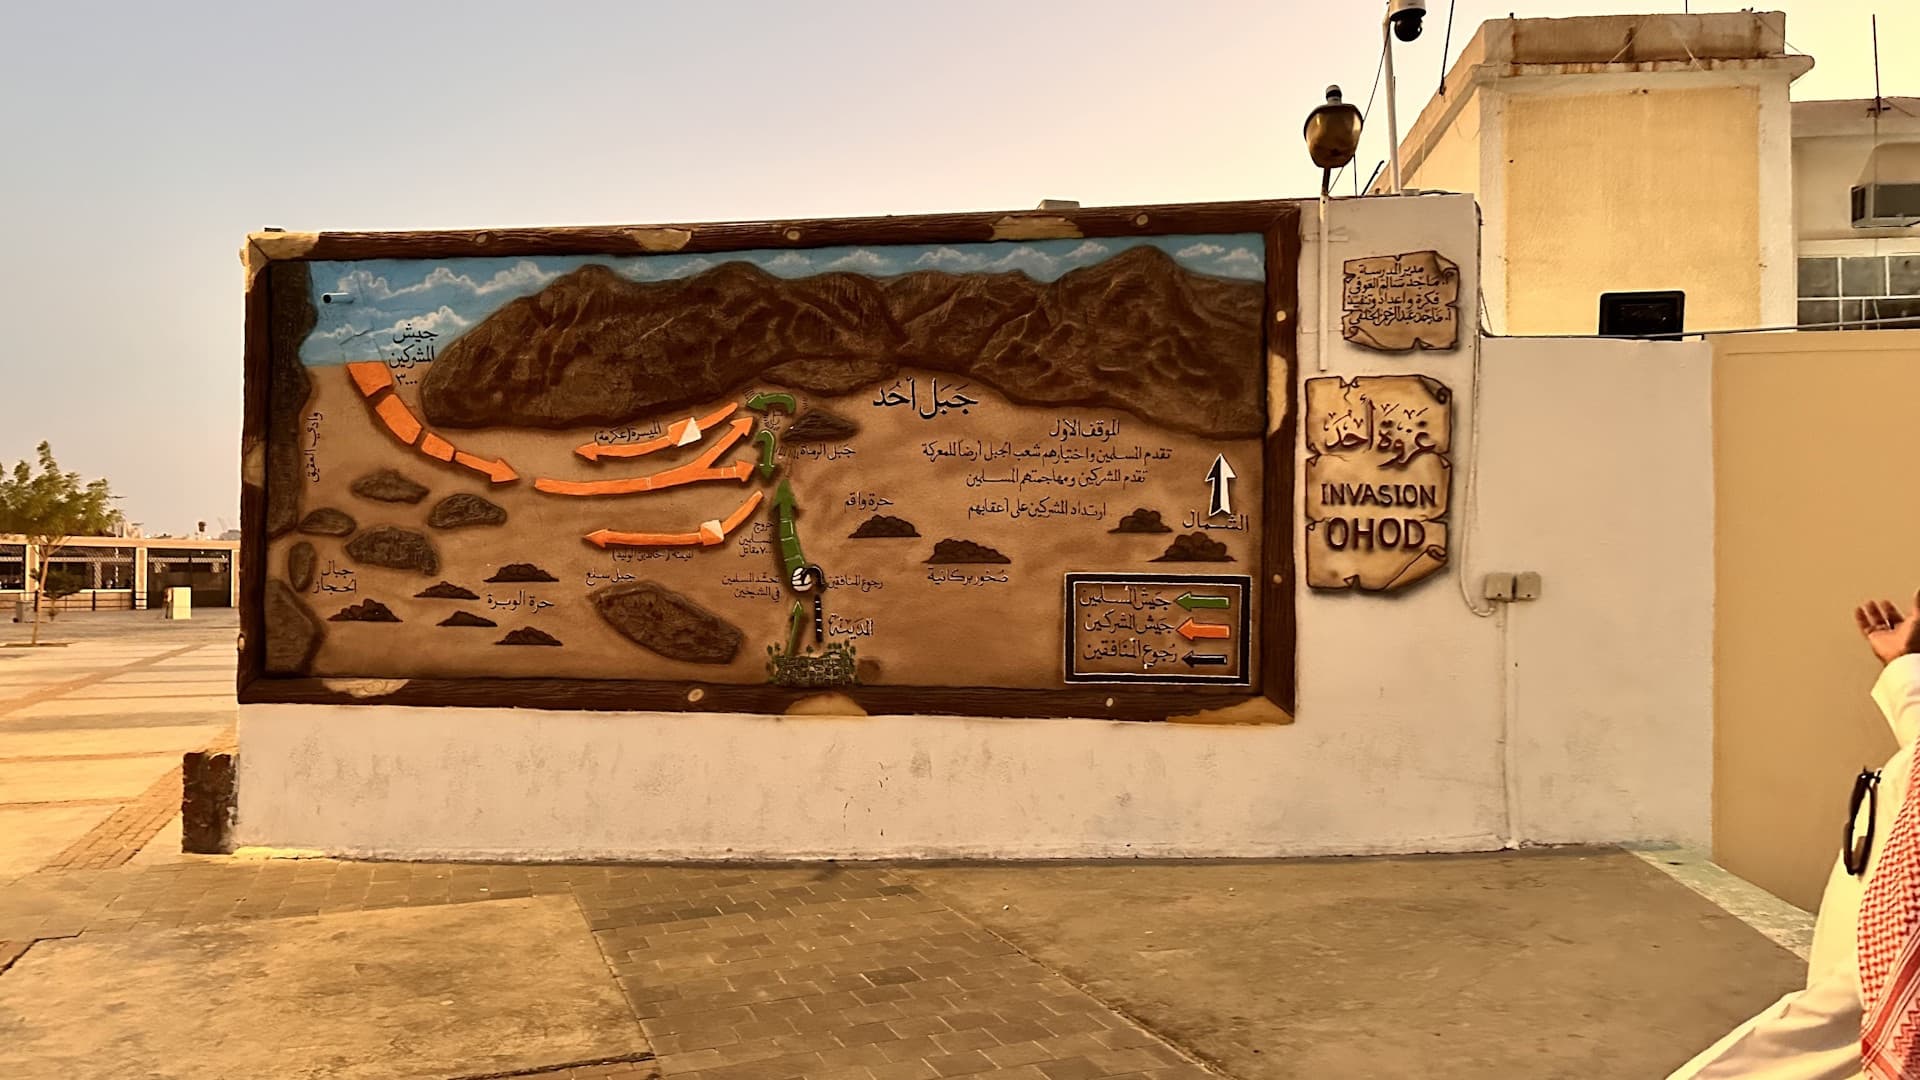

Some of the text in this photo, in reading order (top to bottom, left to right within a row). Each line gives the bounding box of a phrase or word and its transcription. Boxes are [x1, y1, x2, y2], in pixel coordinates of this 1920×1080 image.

[1358, 262, 1425, 278] مدير المدرسة
[1416, 290, 1440, 309] فكرة
[392, 322, 439, 344] جيش
[389, 344, 435, 369] المشركين
[1081, 418, 1120, 442] الموقف
[1096, 445, 1142, 463] المسلمين
[1143, 447, 1173, 466] تقدم
[966, 468, 1019, 487] المسلمين
[1321, 483, 1437, 507] INVASION
[1182, 509, 1249, 533] الشمال
[1327, 517, 1426, 550] OHOD
